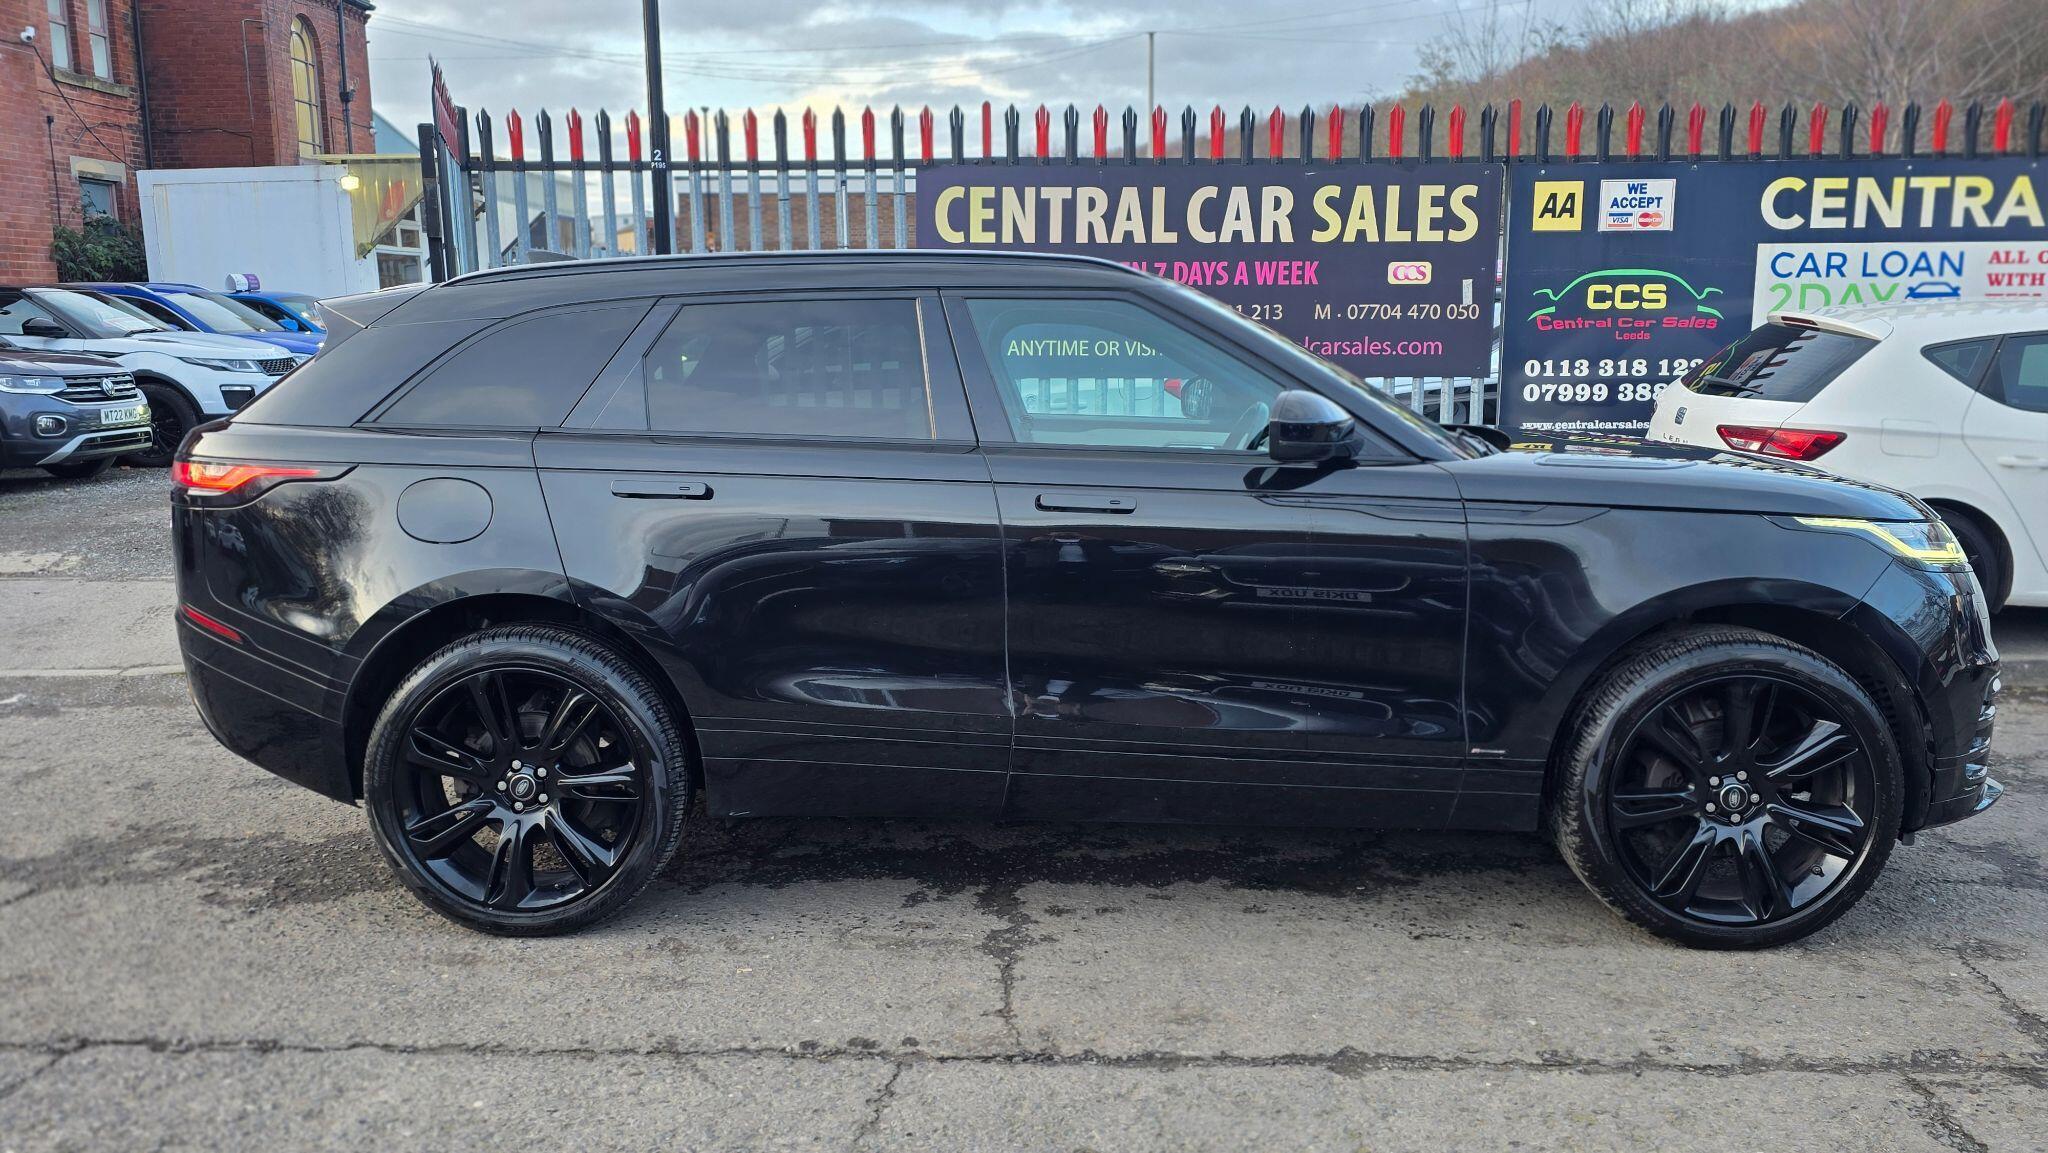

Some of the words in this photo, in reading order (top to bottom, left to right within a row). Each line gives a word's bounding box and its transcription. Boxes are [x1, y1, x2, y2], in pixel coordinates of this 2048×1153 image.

[653, 149, 661, 160] 2
[1627, 183, 1648, 195] WE
[1538, 192, 1577, 220] AA
[1610, 196, 1663, 209] ACCEPT
[934, 185, 1178, 244] CENTRAL
[1187, 185, 1295, 244] CAR
[1311, 185, 1479, 243] SALES
[1770, 251, 1848, 279] CAR
[1861, 250, 1965, 278] LOAN
[1988, 250, 2031, 264] ALL
[1154, 262, 1167, 278] 7
[1173, 261, 1229, 286] DAYS
[1234, 261, 1249, 286] A
[1255, 261, 1320, 286] WEEK
[1392, 265, 1427, 281] CCS
[1987, 272, 2046, 287] WITH
[1586, 283, 1668, 310] CCS
[1768, 282, 1900, 313] 2DAY
[1251, 304, 1283, 320] 213
[1314, 304, 1331, 320] M
[1347, 303, 1402, 320] 07704
[1407, 304, 1441, 320] 470
[1446, 303, 1480, 320] 050
[1536, 315, 1612, 331] Central
[1617, 317, 1657, 328] Car
[1662, 315, 1718, 329] Sales
[1615, 331, 1651, 340] Leeds
[1007, 340, 1089, 356] ANYTIME
[1094, 340, 1120, 356] OR
[1524, 359, 1590, 377] 0113
[1598, 358, 1648, 377] 318
[1523, 383, 1609, 402] 07999
[104, 410, 123, 421] MT22
